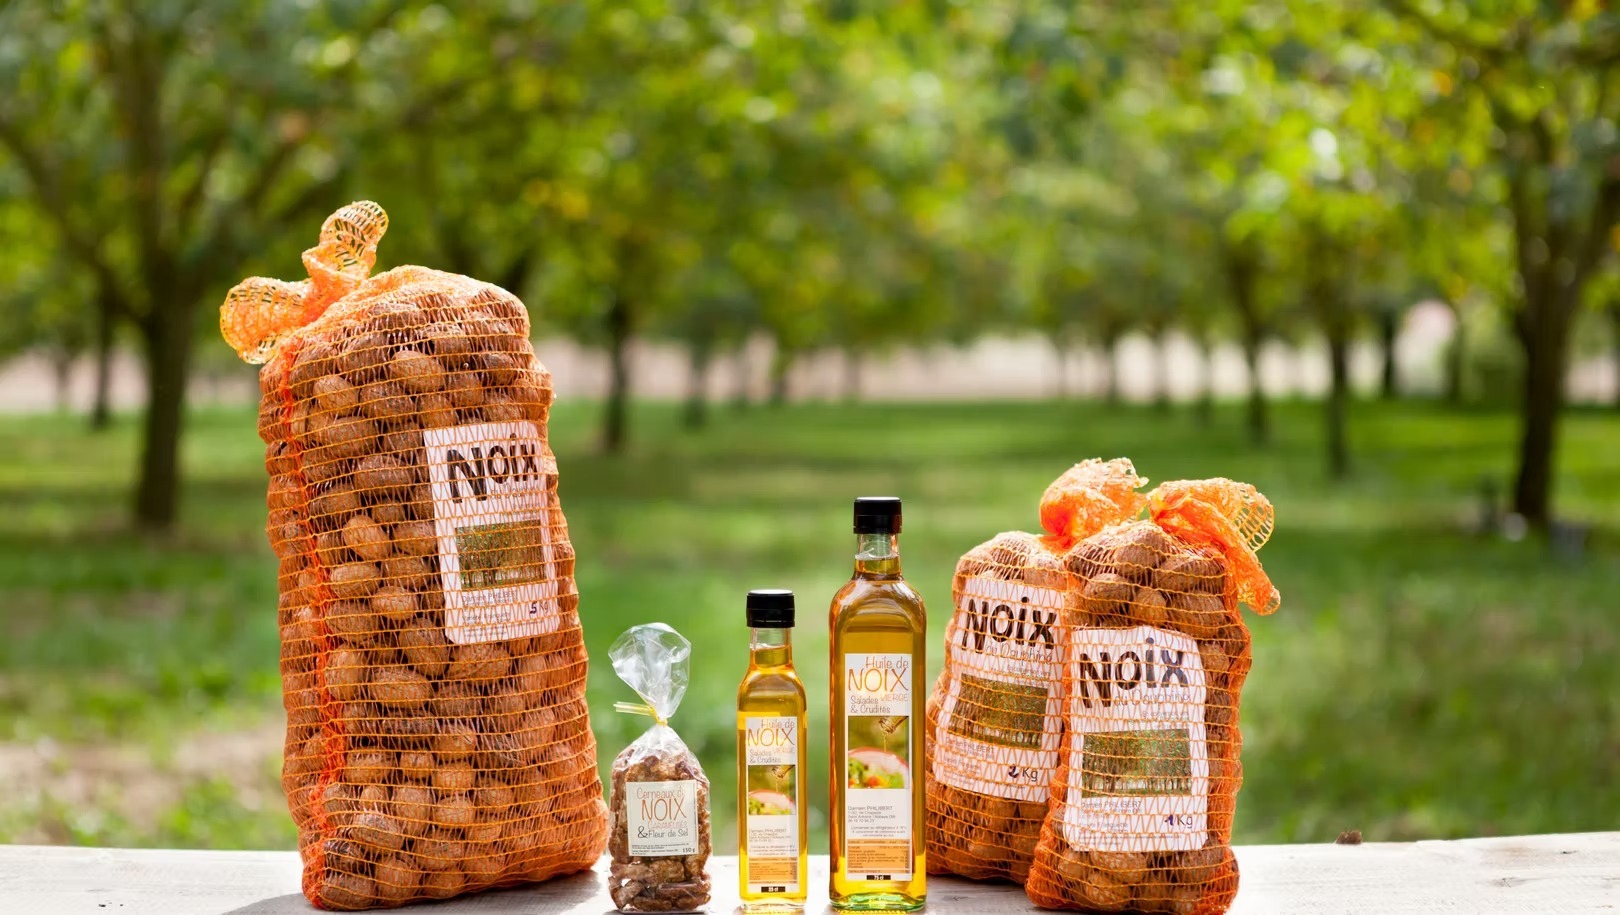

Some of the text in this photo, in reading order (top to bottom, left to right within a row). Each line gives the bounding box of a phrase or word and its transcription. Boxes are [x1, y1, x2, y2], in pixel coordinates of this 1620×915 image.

[529, 601, 538, 615] 5
[865, 656, 909, 669] Huile de
[848, 668, 909, 692] NOIX
[850, 695, 879, 705] Salades
[850, 704, 891, 714] & Crudités
[761, 718, 795, 728] Huile de
[748, 728, 795, 746] NOIX
[1022, 768, 1038, 782] Kg
[637, 786, 675, 799] Cerneaux
[641, 796, 687, 821] NOIX
[1164, 814, 1193, 829] 1 Kg
[637, 826, 689, 838] & Fleur de Sel
